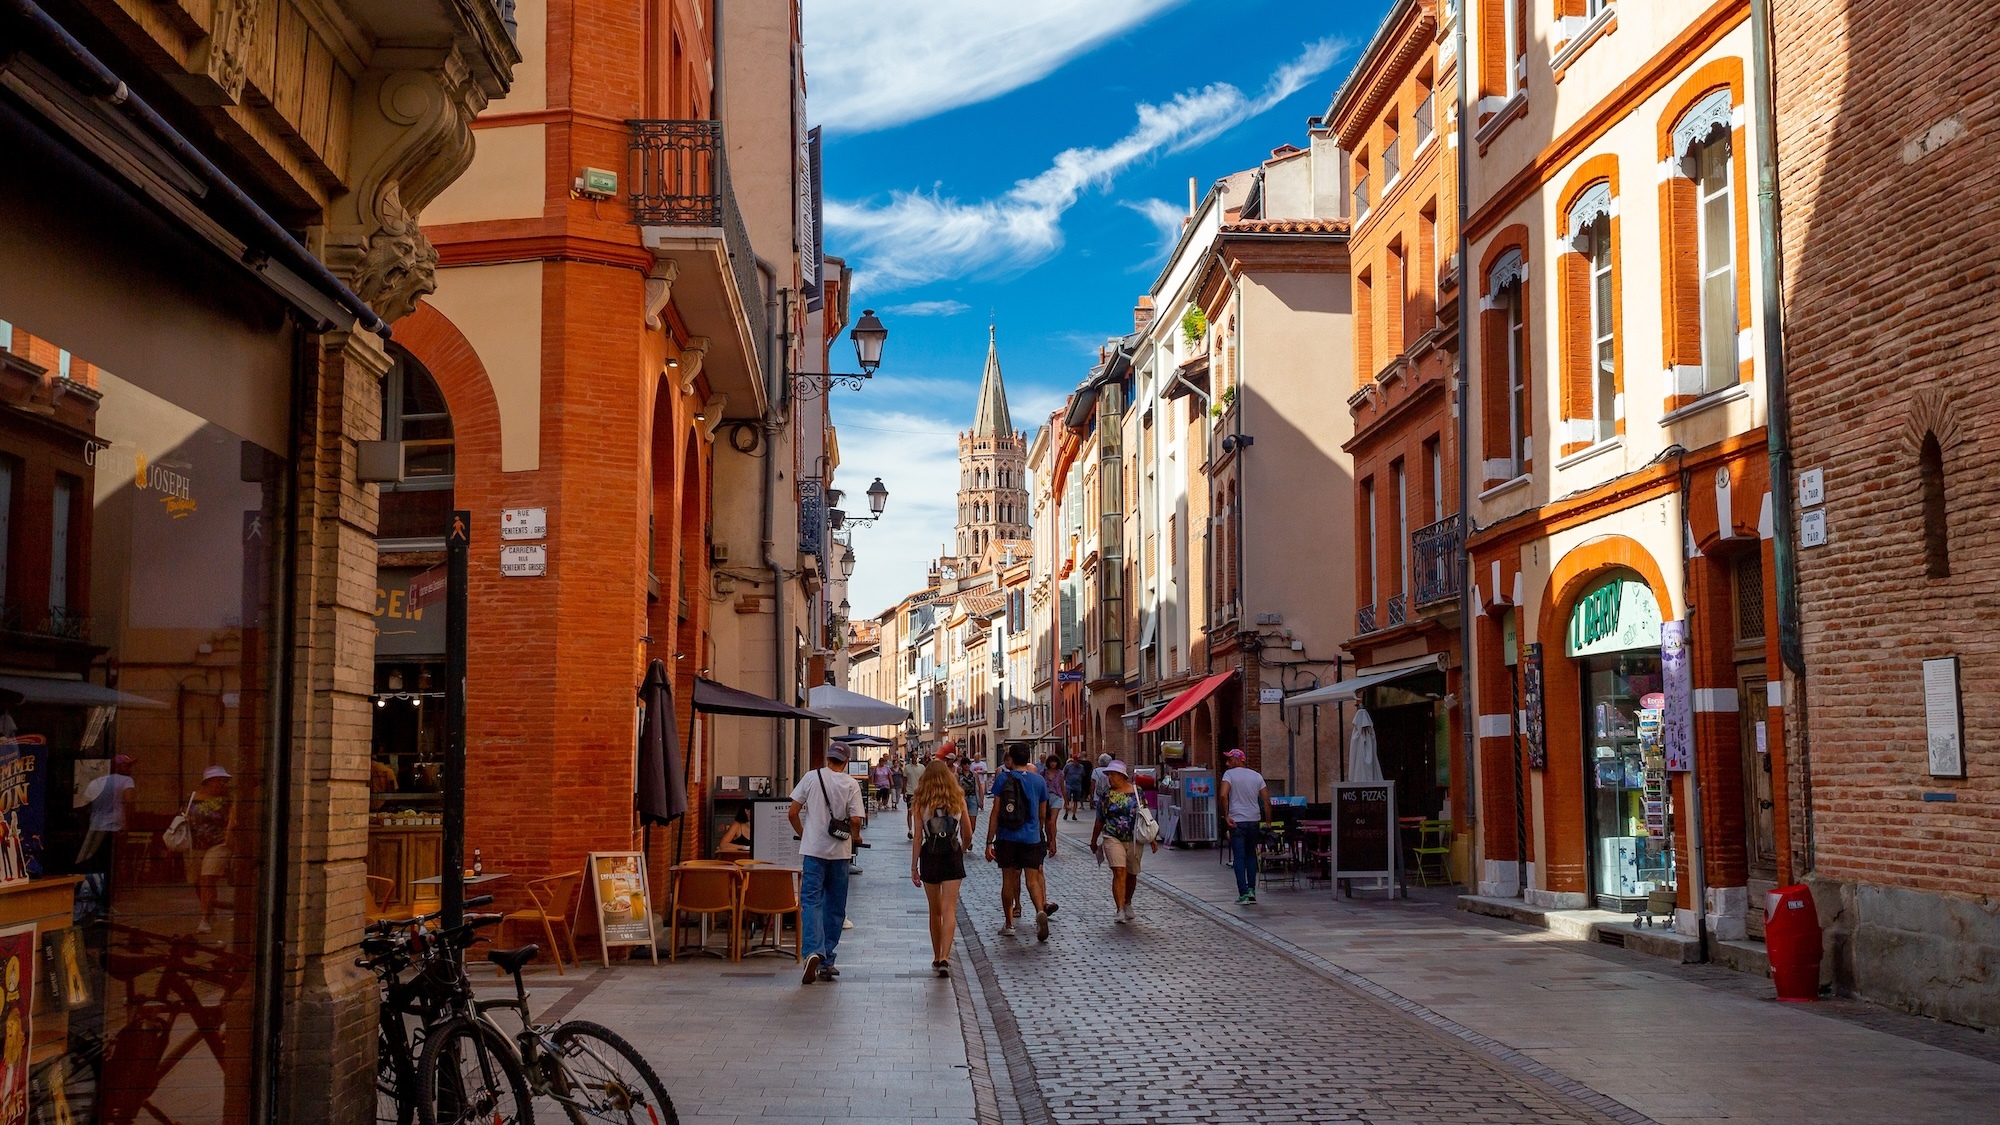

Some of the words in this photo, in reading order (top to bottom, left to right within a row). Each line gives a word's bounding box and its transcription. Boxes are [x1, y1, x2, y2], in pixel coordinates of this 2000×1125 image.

[149, 465, 190, 500] JOSEPH
[1808, 488, 1819, 499] TAUR
[1807, 531, 1819, 542] TAUR
[1342, 791, 1357, 801] NOS
[1361, 790, 1386, 801] PIZZAS
